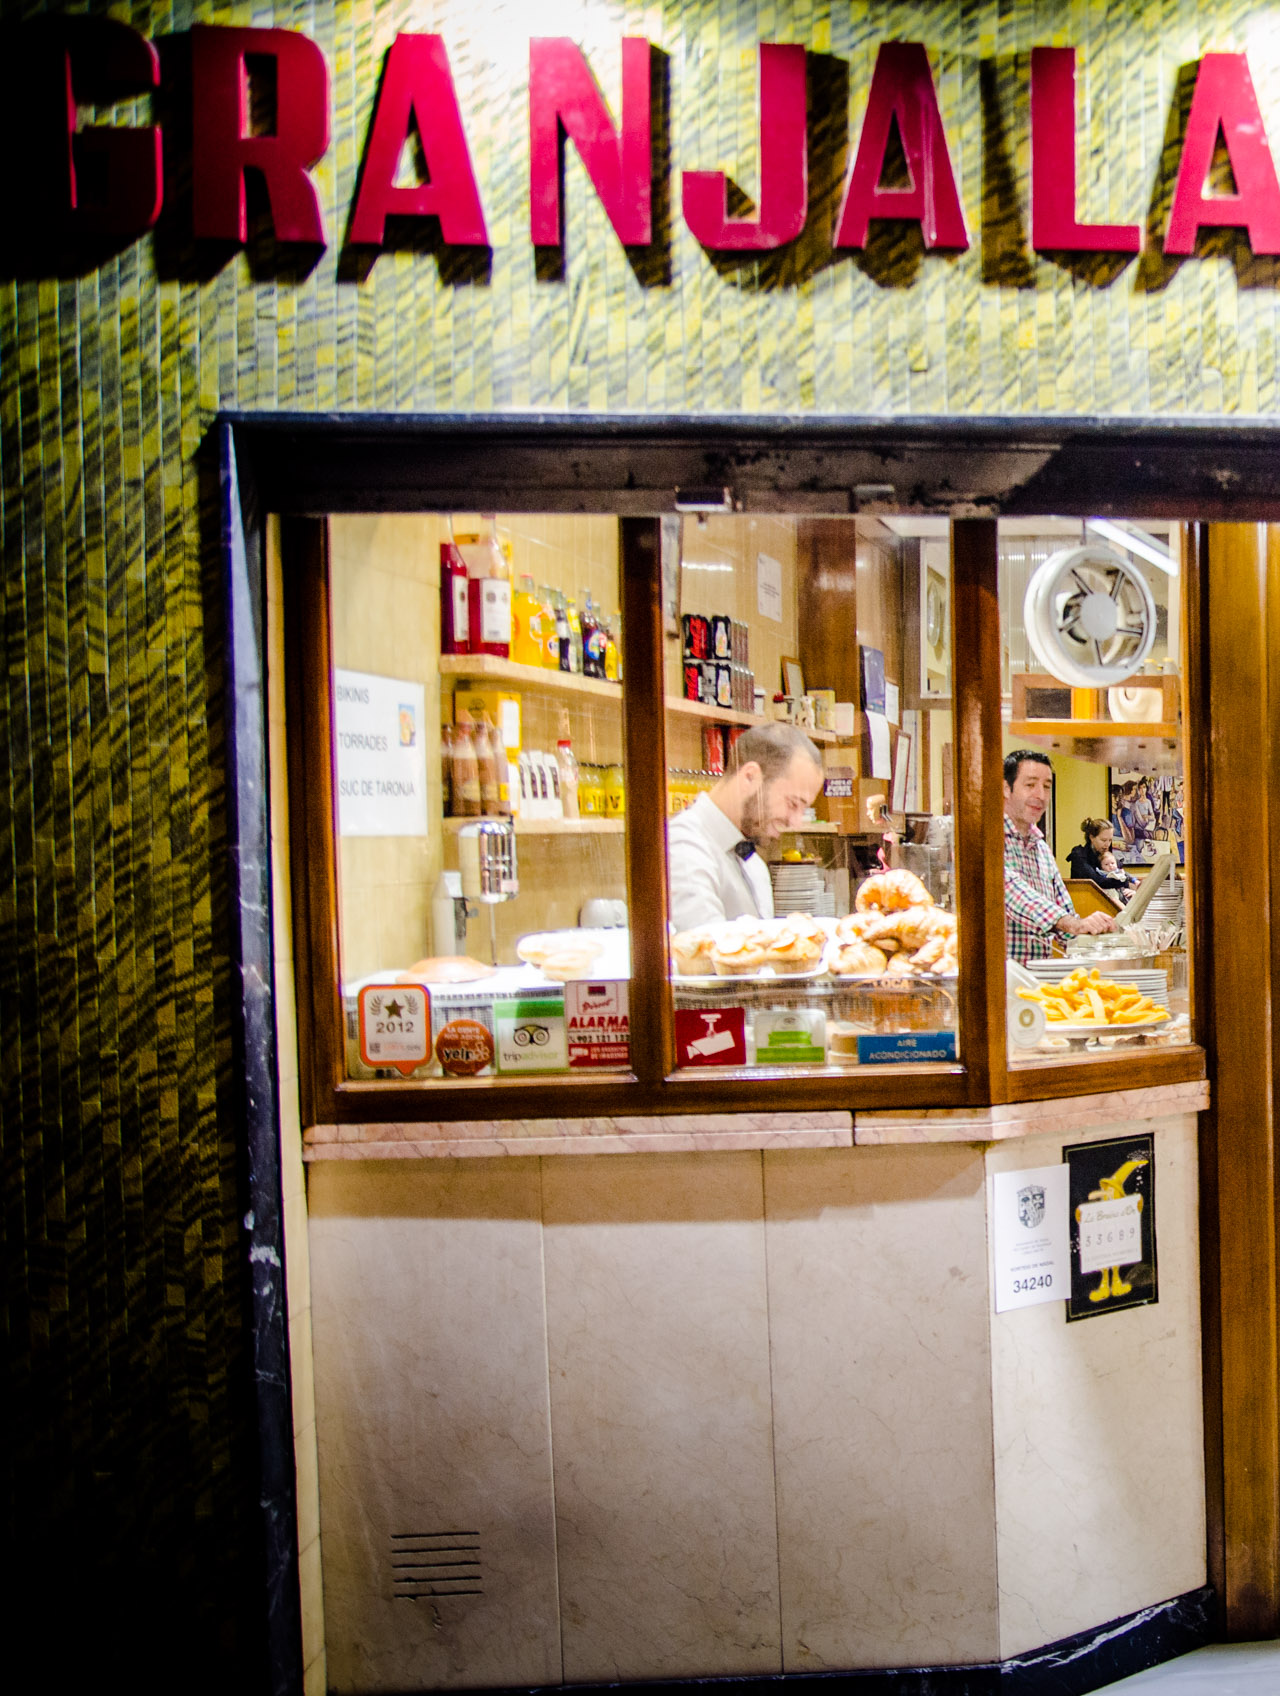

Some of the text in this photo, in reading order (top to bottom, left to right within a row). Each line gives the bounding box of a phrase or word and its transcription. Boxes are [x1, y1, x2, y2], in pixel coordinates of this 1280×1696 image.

[18, 18, 970, 251] GRANJA
[338, 732, 389, 753] TORRADES
[340, 780, 416, 798] SUC DE TARONJA
[376, 1021, 414, 1034] 2012
[568, 1016, 629, 1029] ALARMA
[896, 1038, 917, 1048] AIRE
[443, 1048, 474, 1062] yelp
[503, 1051, 558, 1062] tripadvisor
[869, 1049, 948, 1060] ACONDICIONADO
[1012, 1273, 1053, 1294] 34240
